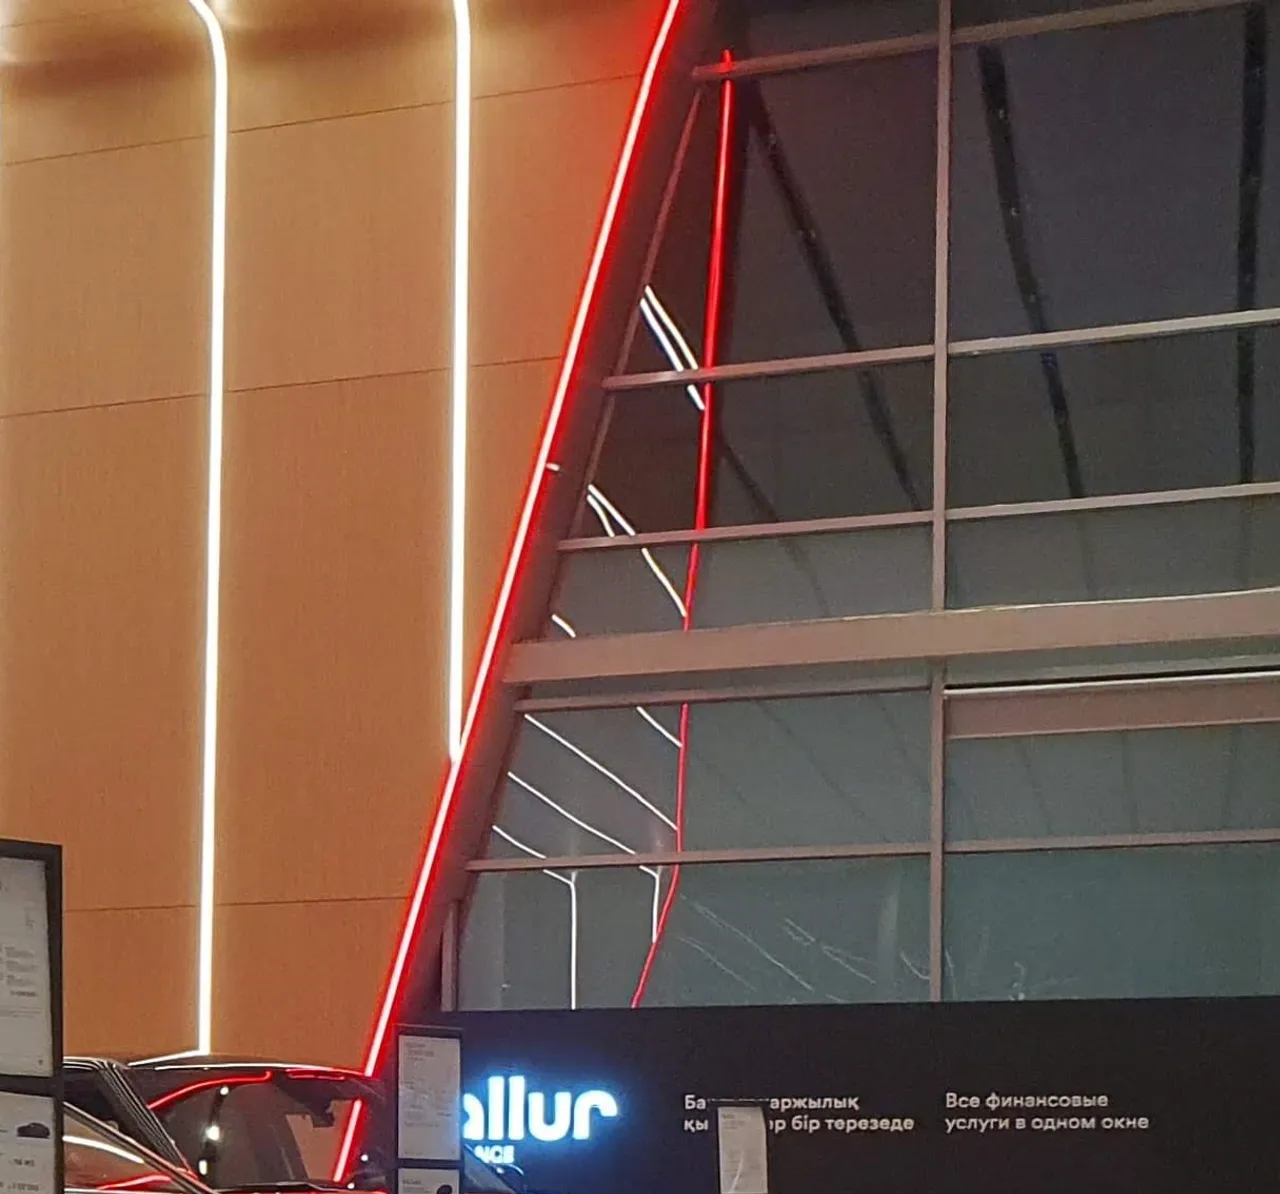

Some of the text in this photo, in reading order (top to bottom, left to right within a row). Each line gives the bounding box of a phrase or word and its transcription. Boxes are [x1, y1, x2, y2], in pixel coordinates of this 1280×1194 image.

[770, 1095, 860, 1111] аржылық
[945, 1092, 1108, 1111] Все финансовые
[791, 1114, 821, 1133] бір
[945, 1116, 1149, 1133] услуги в одном окне
